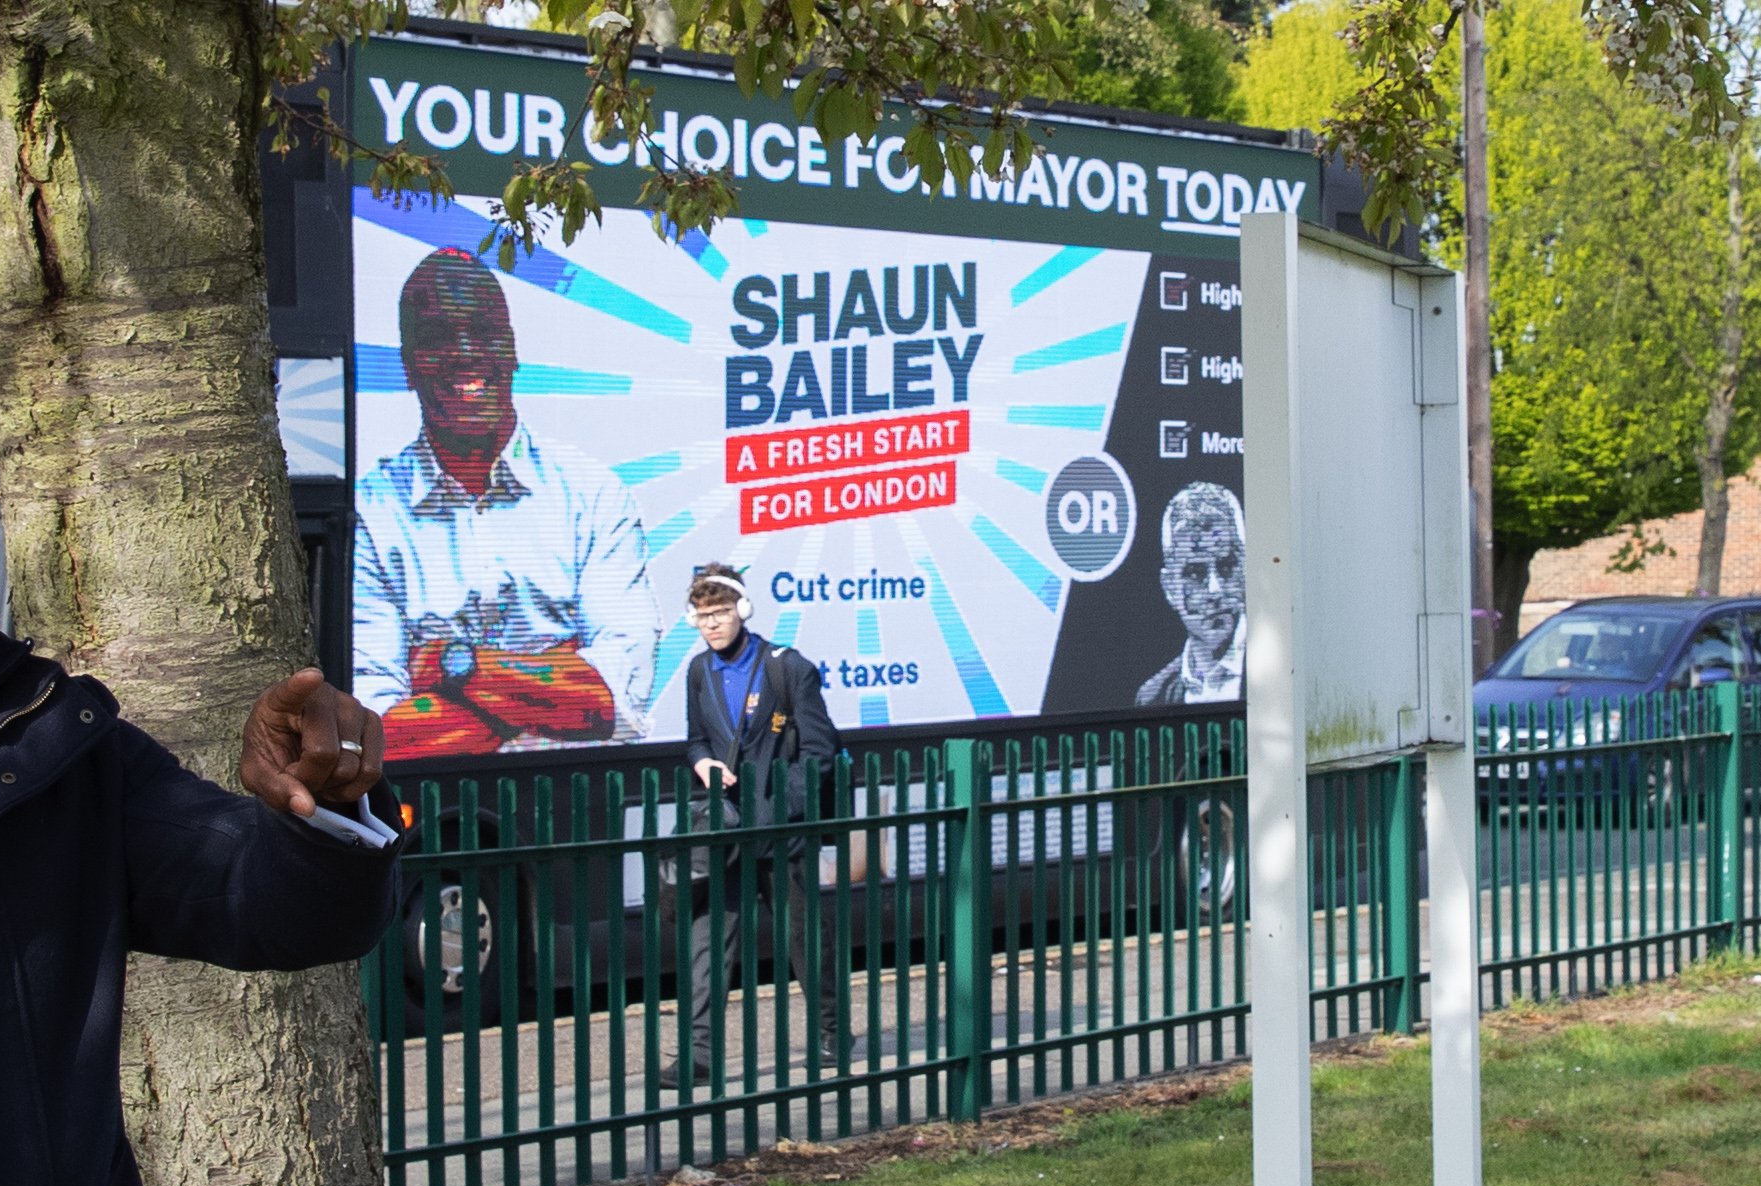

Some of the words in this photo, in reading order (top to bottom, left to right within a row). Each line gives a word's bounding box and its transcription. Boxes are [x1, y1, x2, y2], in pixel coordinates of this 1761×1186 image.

[368, 77, 567, 159] YOUR
[582, 106, 831, 188] CHOICE
[1157, 166, 1306, 224] TODAY
[730, 261, 977, 350] SHAUN
[725, 333, 984, 429] BAILEY
[737, 445, 757, 472] A
[768, 431, 863, 468] FRESH
[874, 420, 960, 454] START
[752, 490, 812, 524] FOR
[824, 471, 947, 513] LONDON
[1058, 490, 1118, 534] OR
[771, 571, 830, 603] Cut
[838, 568, 925, 600] crime
[839, 659, 918, 688] taxes
